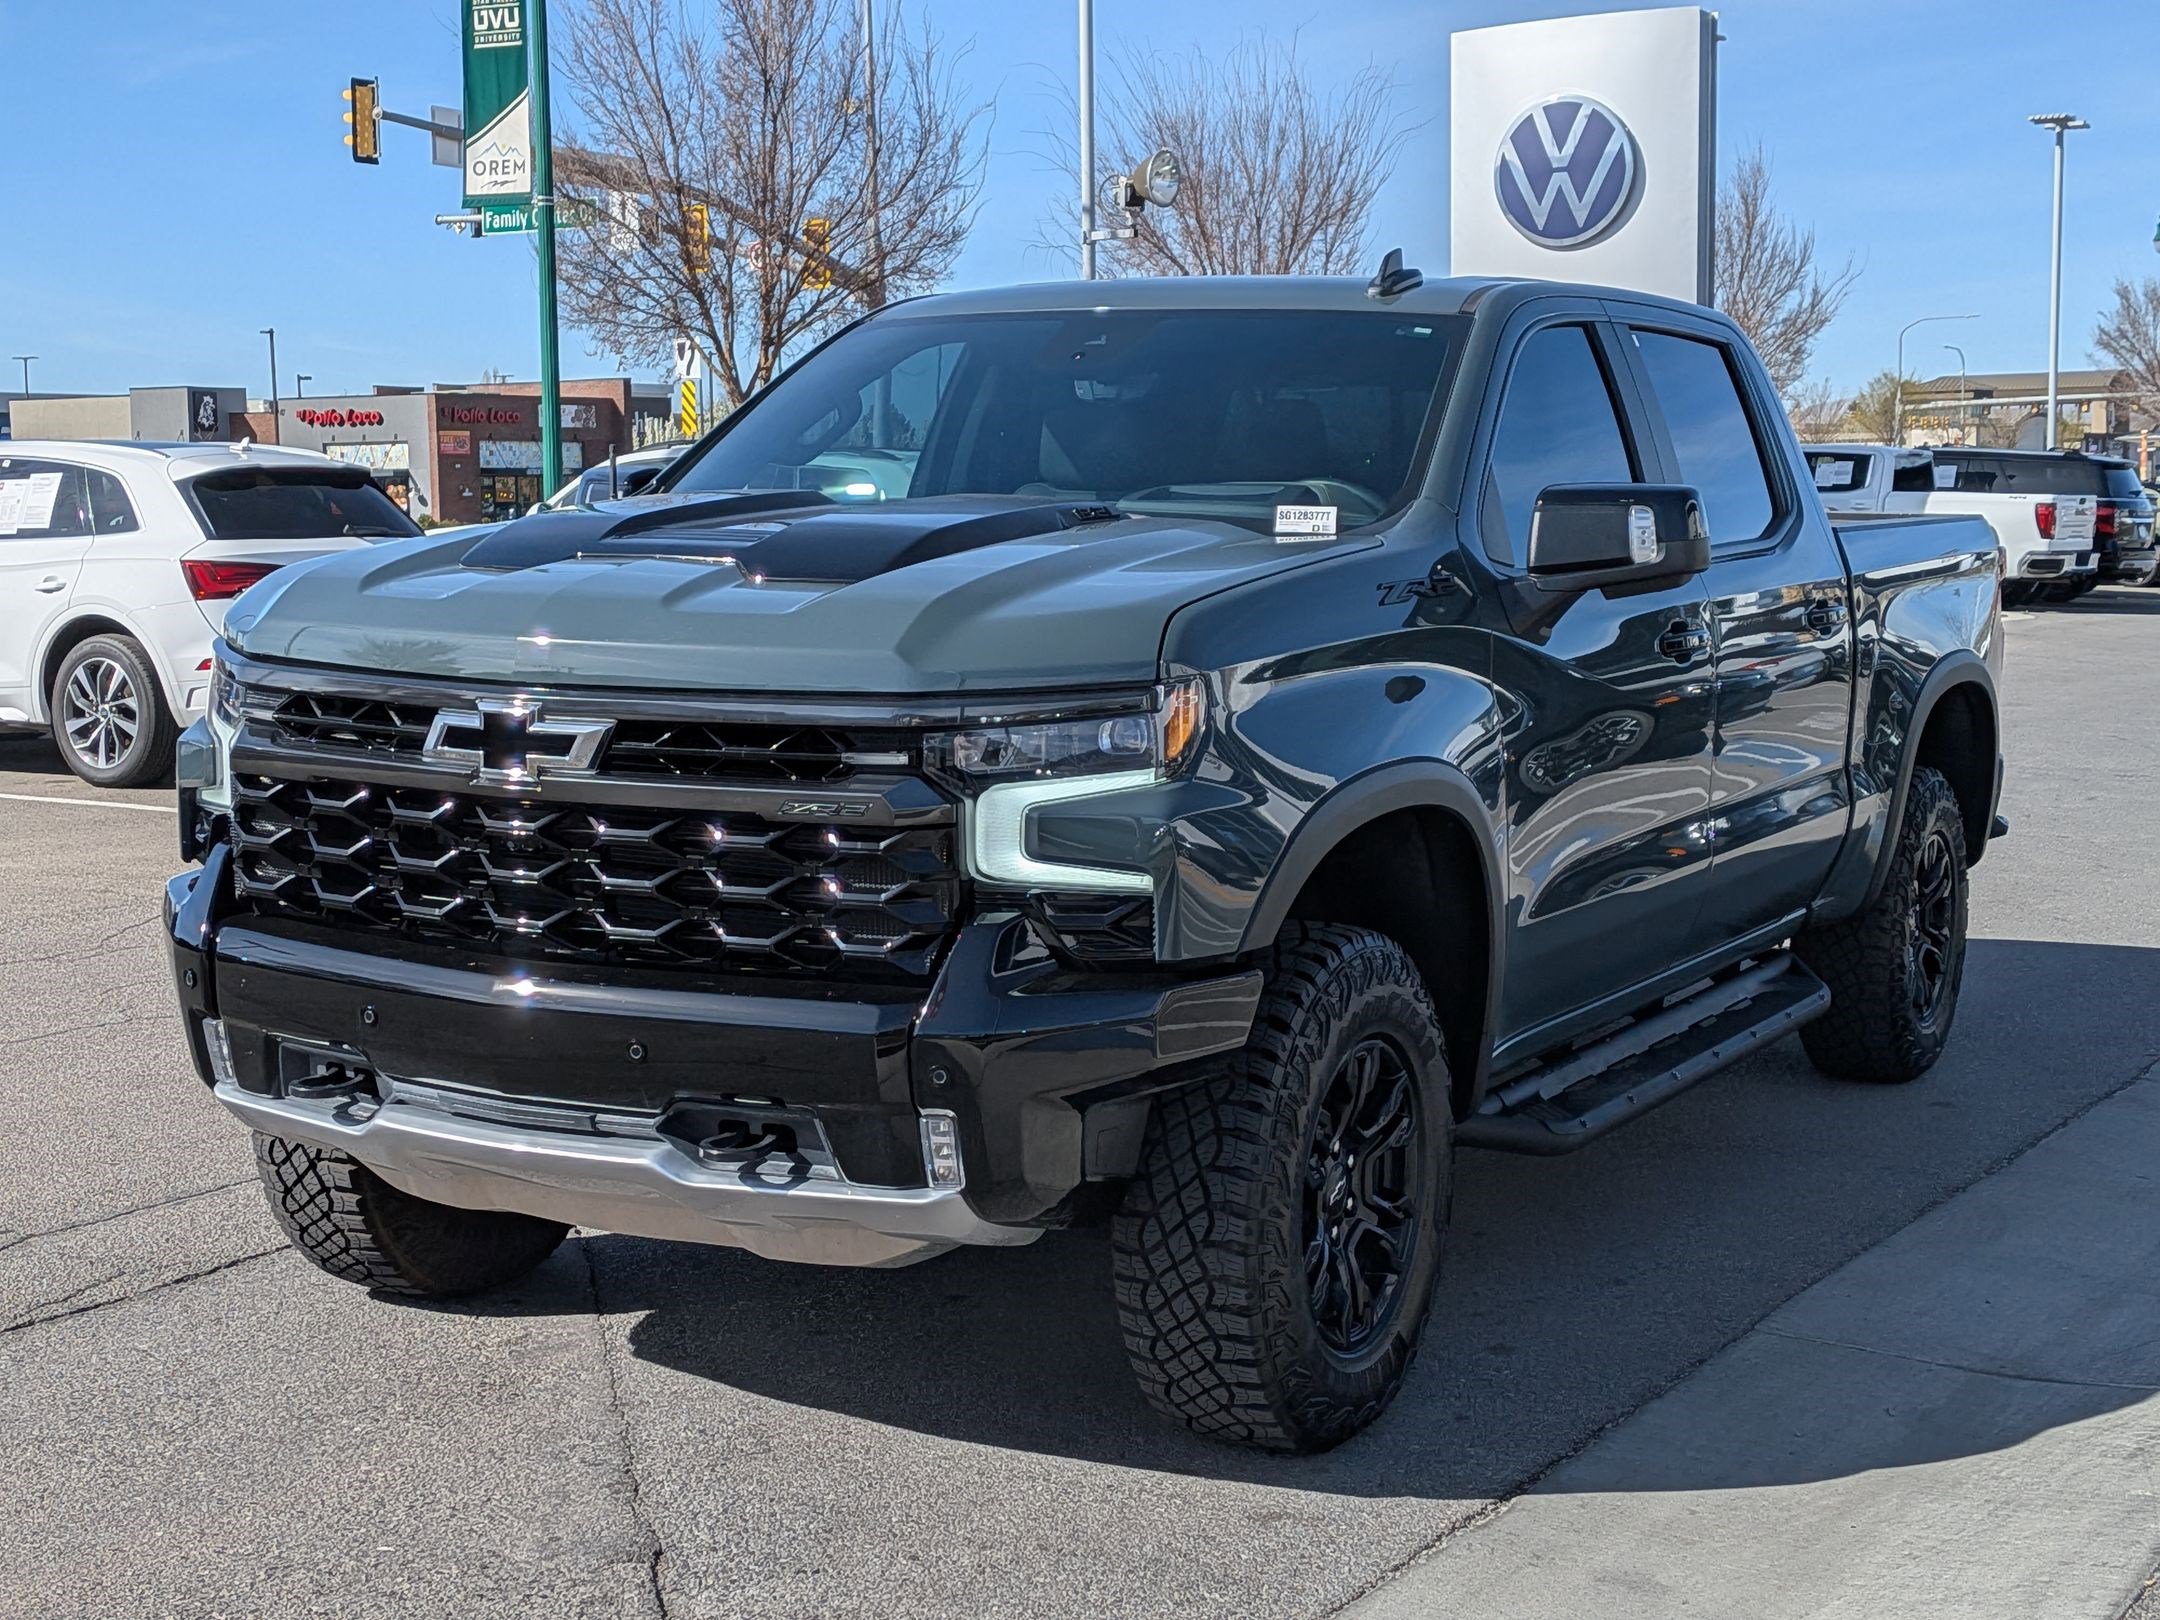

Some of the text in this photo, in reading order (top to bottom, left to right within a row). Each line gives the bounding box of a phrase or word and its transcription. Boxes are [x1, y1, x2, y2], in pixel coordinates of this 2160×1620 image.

[473, 7, 520, 31] UVU
[474, 32, 521, 44] UNIVERSITY
[472, 159, 526, 176] OREM
[485, 209, 528, 231] Family
[532, 205, 576, 228] Cter
[304, 407, 342, 425] Pollo
[344, 407, 381, 425] Loco
[453, 406, 487, 424] Pollo
[490, 406, 521, 423] Loco
[1279, 510, 1331, 521] SG128377T
[778, 799, 873, 817] ZR2
